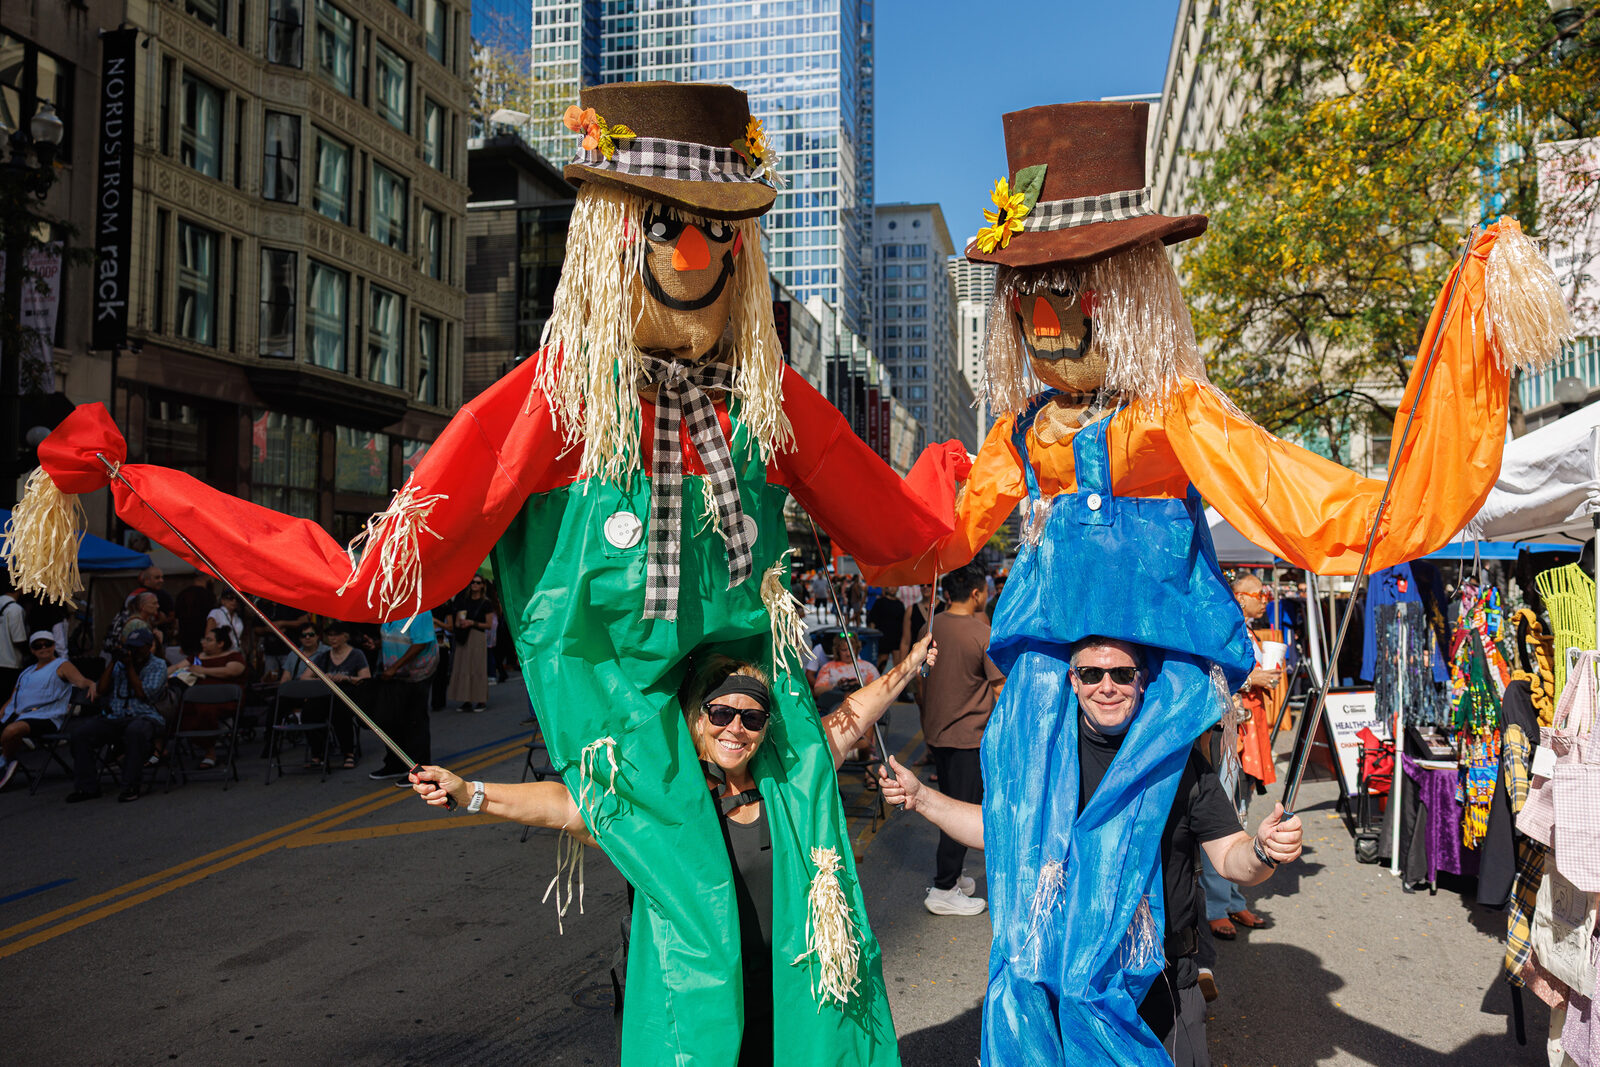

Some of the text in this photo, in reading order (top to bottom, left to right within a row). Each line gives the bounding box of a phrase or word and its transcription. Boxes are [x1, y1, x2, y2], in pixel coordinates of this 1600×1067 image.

[98, 58, 125, 320] NORDSTROM rack
[1335, 721, 1381, 729] HEALTHCARE
